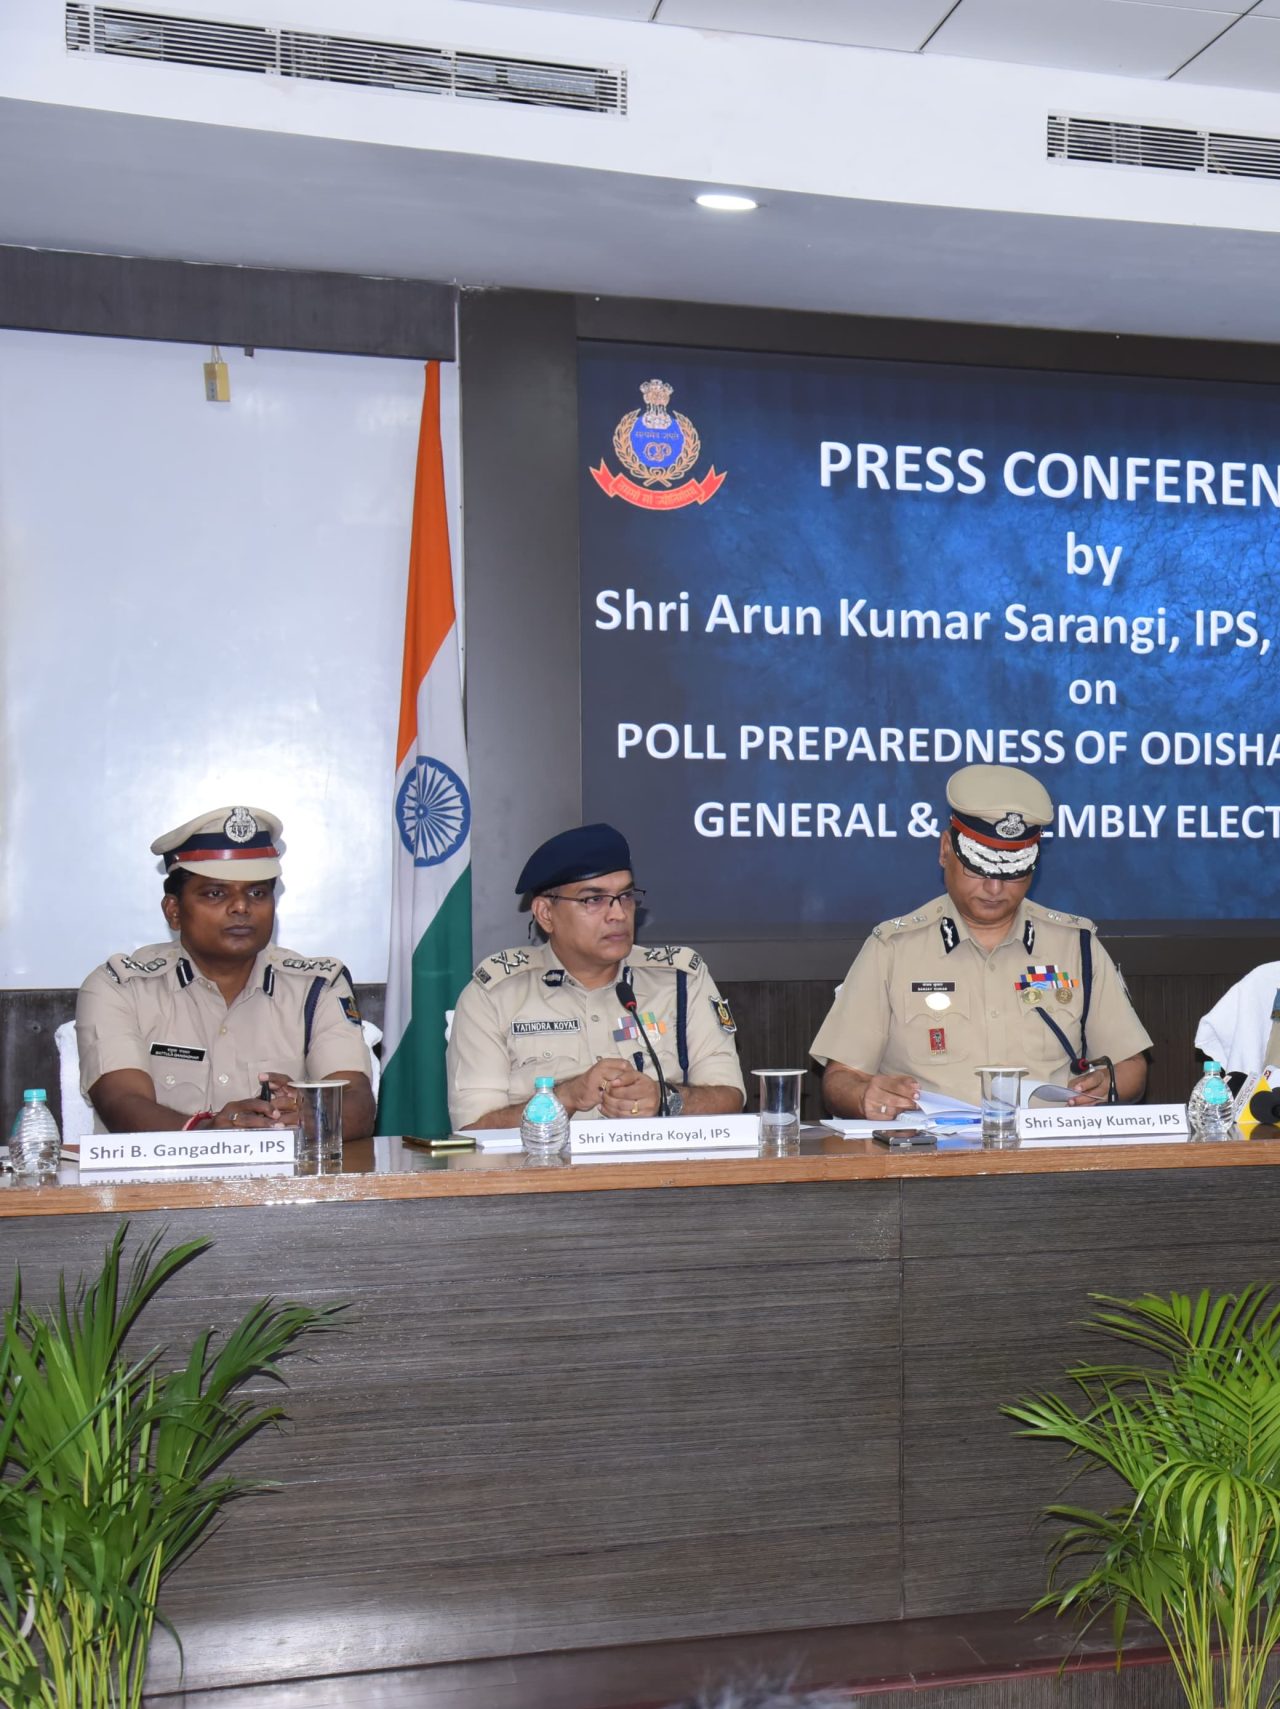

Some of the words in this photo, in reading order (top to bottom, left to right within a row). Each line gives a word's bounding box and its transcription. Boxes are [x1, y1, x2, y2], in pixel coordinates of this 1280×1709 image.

[820, 441, 986, 495] PRESS
[1066, 531, 1123, 587] by
[595, 588, 689, 632] Shri
[705, 594, 822, 636] Arun
[840, 598, 991, 640] Kumar
[1004, 603, 1180, 655] Sarangi,
[1195, 609, 1271, 656] IPS,
[1068, 679, 1118, 705] on
[617, 723, 727, 760] POLL
[740, 725, 1065, 764] PREPAREDNESS
[1075, 730, 1128, 765] OF
[694, 801, 897, 838] GENERAL
[907, 802, 941, 838] &
[1041, 803, 1167, 839] MBLY
[515, 1022, 552, 1032] YATINDRA
[553, 1020, 578, 1031] KOYAL
[578, 1132, 605, 1145] Shri
[608, 1130, 663, 1143] Yatindra
[668, 1129, 707, 1142] Koyal,
[711, 1128, 731, 1139] IPS
[1025, 1116, 1052, 1129] Shri
[1056, 1115, 1101, 1130] Sanjay
[1106, 1115, 1155, 1127] Kumar,
[1159, 1114, 1180, 1125] IPS
[89, 1145, 124, 1160] Shri
[131, 1145, 148, 1158] B.
[153, 1142, 254, 1159] Gangadhar,
[260, 1140, 286, 1153] IPS
